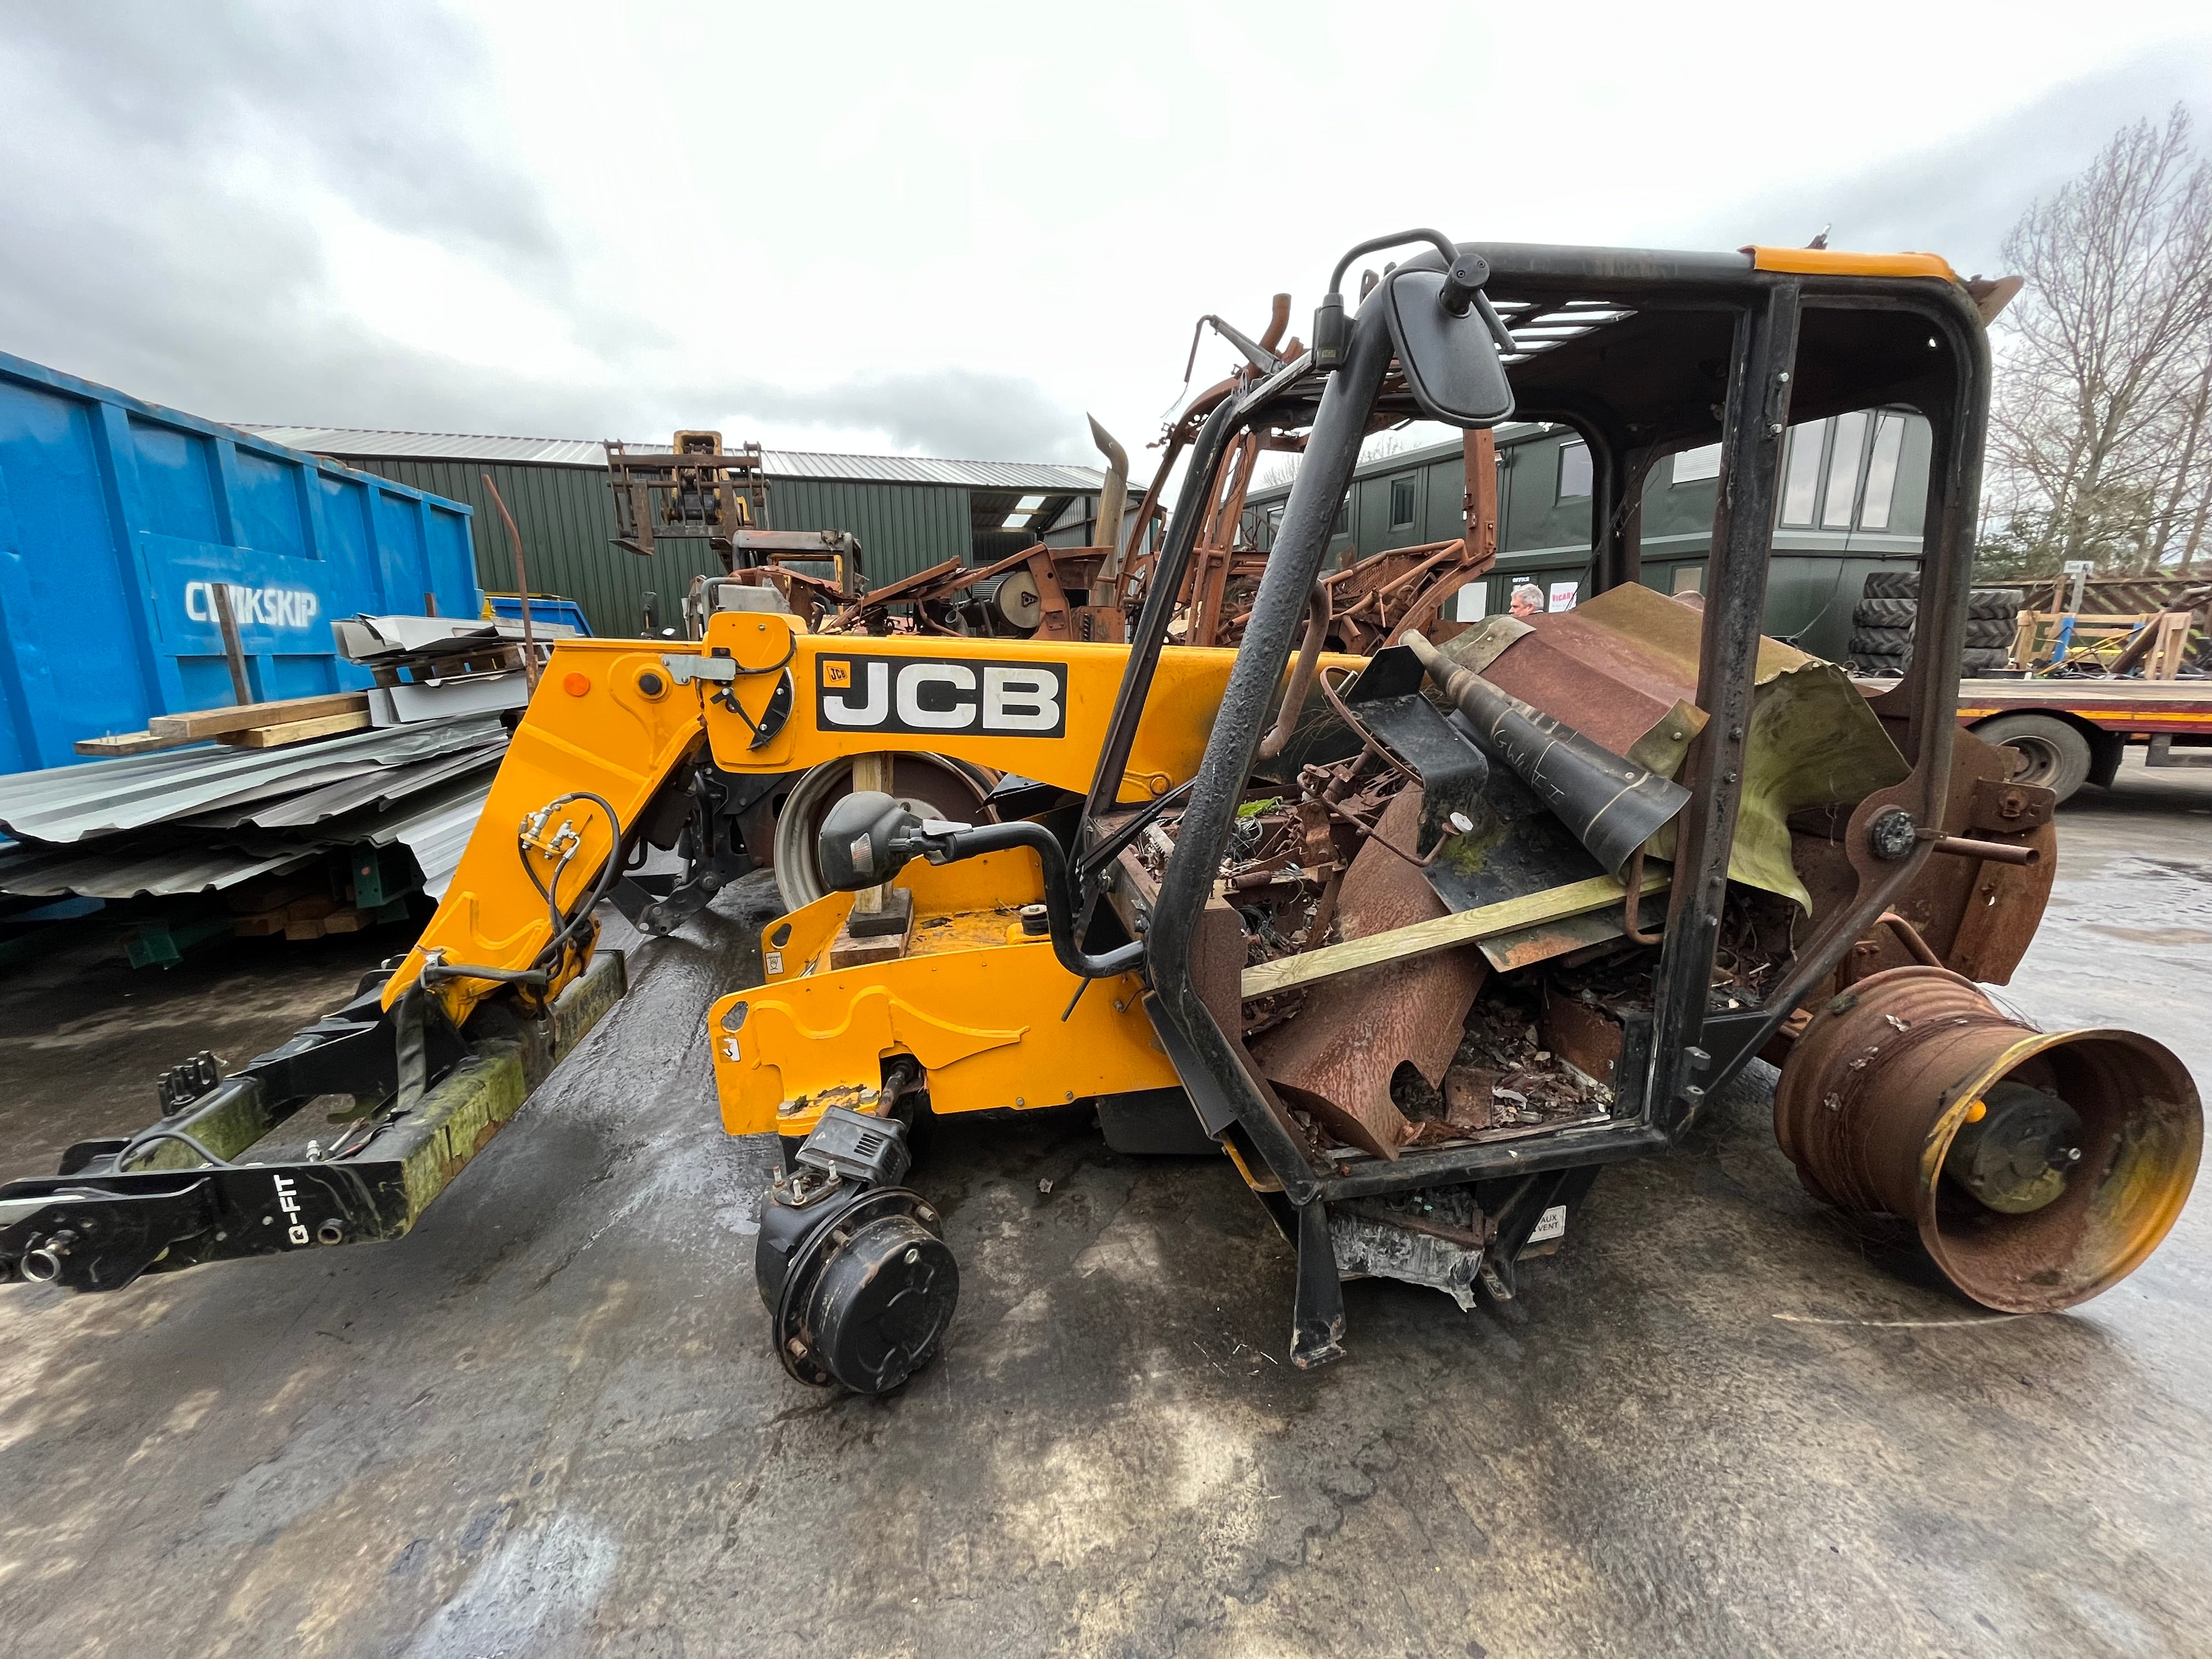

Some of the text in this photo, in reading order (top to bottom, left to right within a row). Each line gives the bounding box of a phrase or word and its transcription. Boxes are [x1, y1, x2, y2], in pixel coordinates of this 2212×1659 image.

[830, 668, 846, 680] JCB
[823, 662, 1060, 731] JCB
[273, 1174, 309, 1245] Q-FIT
[1540, 1214, 1557, 1224] AUX
[1538, 1221, 1558, 1232] VENT
